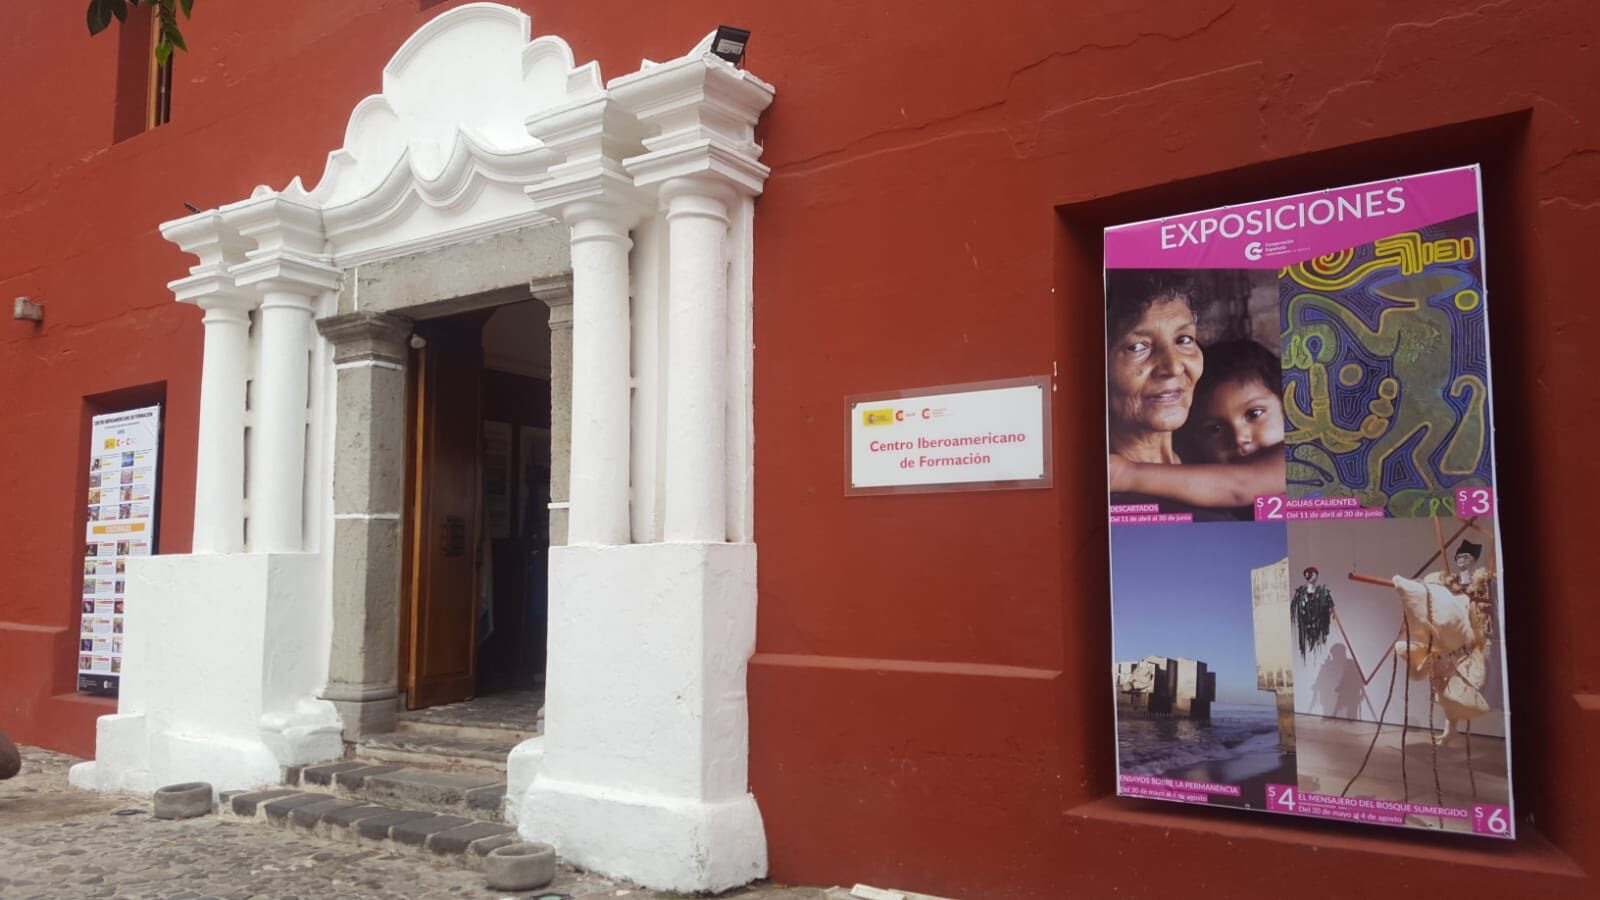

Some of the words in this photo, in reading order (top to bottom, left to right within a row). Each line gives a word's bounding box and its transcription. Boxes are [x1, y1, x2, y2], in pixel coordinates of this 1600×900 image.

[1160, 186, 1406, 250] EXPOSICIONES
[870, 439, 914, 453] Centro
[917, 431, 1026, 450] Iberoamericano
[899, 456, 915, 469] de
[919, 452, 991, 468] Formación
[1110, 504, 1159, 513] DESCARTADOS
[1267, 496, 1283, 519] 2
[1286, 499, 1313, 507] AGUAS
[1314, 498, 1357, 506] CALIENTES
[1471, 489, 1490, 514] 3
[1320, 510, 1335, 518] abril
[1364, 510, 1384, 518] junio
[1119, 774, 1150, 784] ENSAYOS
[1174, 780, 1184, 788] LA
[1185, 780, 1239, 794] PERMANENCIA
[1278, 787, 1296, 810] 4
[1298, 793, 1307, 801] EL
[1308, 794, 1357, 807] MENSAJERO
[1359, 799, 1374, 809] DEL
[1376, 801, 1412, 812] BOSQUE
[1413, 804, 1468, 818] SUMERGIDO
[1298, 805, 1311, 813] Del
[1332, 810, 1352, 819] mayo
[1378, 814, 1402, 824] agosto
[1487, 808, 1507, 833] 6
